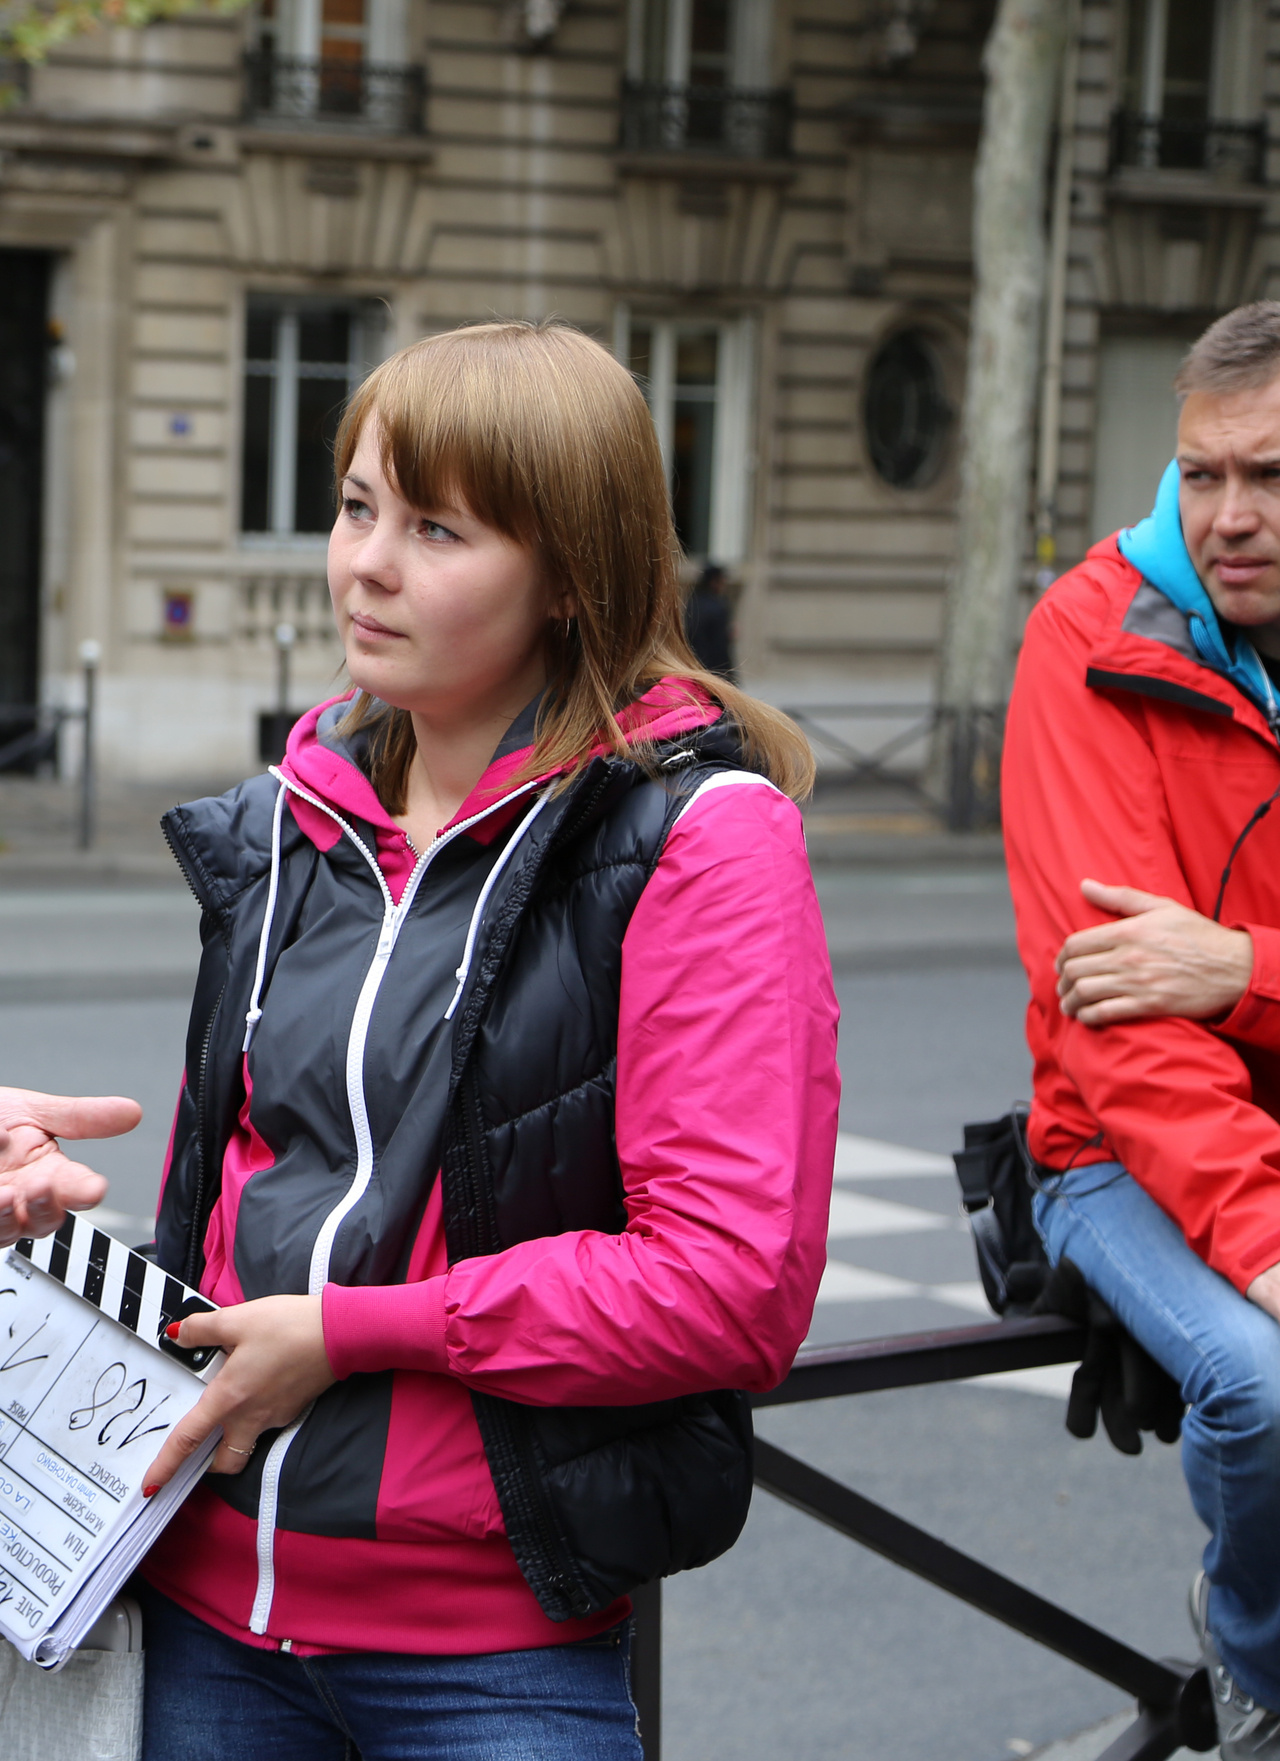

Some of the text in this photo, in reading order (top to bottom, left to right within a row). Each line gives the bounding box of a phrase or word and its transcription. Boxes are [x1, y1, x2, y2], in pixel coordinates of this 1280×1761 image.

[7, 1400, 29, 1421] PRISE
[68, 1361, 170, 1449] 128
[36, 1452, 96, 1503] Dimitri DIATCHENKO
[87, 1461, 129, 1498] SEQUENCE
[14, 1491, 30, 1509] LA
[63, 1531, 89, 1561] FILM
[14, 1595, 43, 1628] DATE
